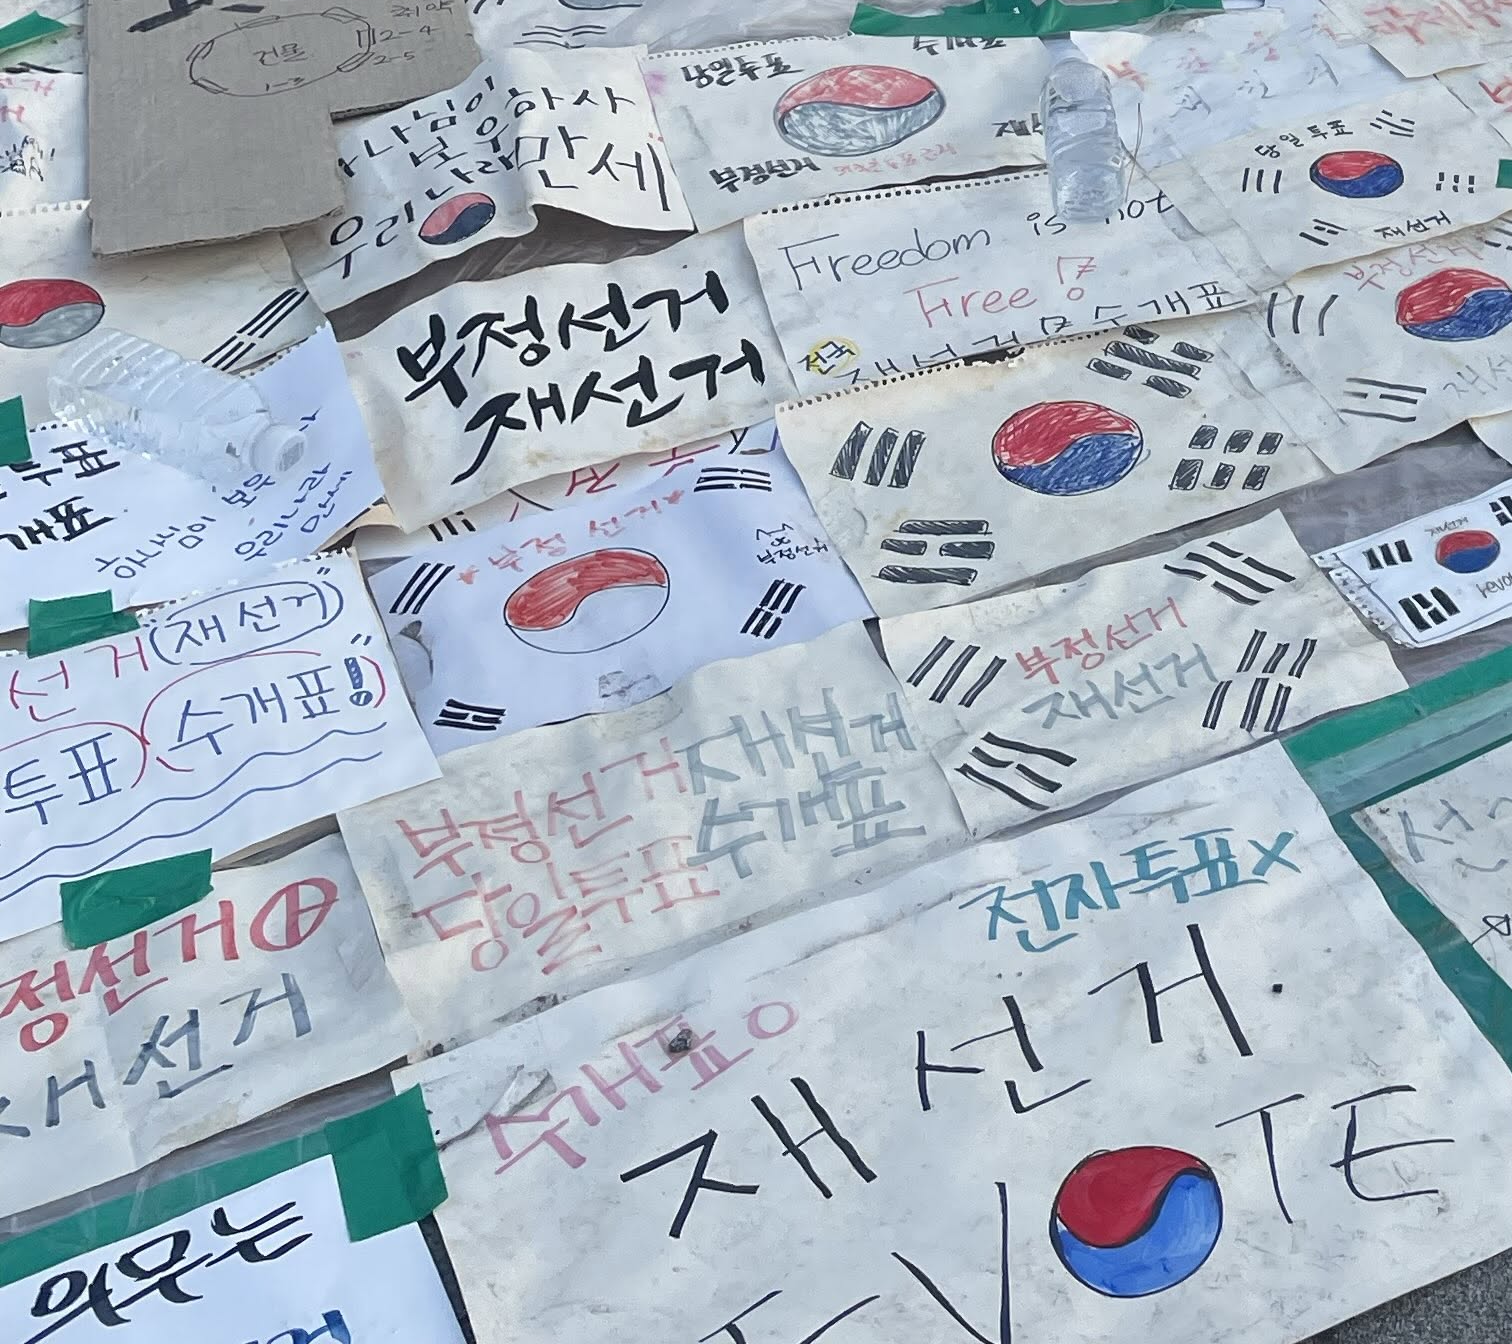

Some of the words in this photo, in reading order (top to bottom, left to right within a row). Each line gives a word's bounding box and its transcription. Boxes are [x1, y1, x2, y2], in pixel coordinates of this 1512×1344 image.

[680, 52, 805, 89] 당일투표
[516, 124, 672, 213] 만세
[709, 156, 821, 193] 부정선거
[777, 225, 992, 290] Freedom
[1026, 211, 1067, 237] is
[1374, 209, 1454, 242] 재선거
[396, 269, 731, 407] 부정선거
[905, 275, 1038, 329] Free
[450, 337, 766, 486] 재선거
[1015, 596, 1191, 686] 부정선거
[1023, 643, 1223, 733] 재선거
[395, 735, 691, 880] 부정선거
[681, 686, 920, 797] 재선거
[412, 832, 723, 978] 당일투표
[618, 921, 1255, 1240] 재선거
